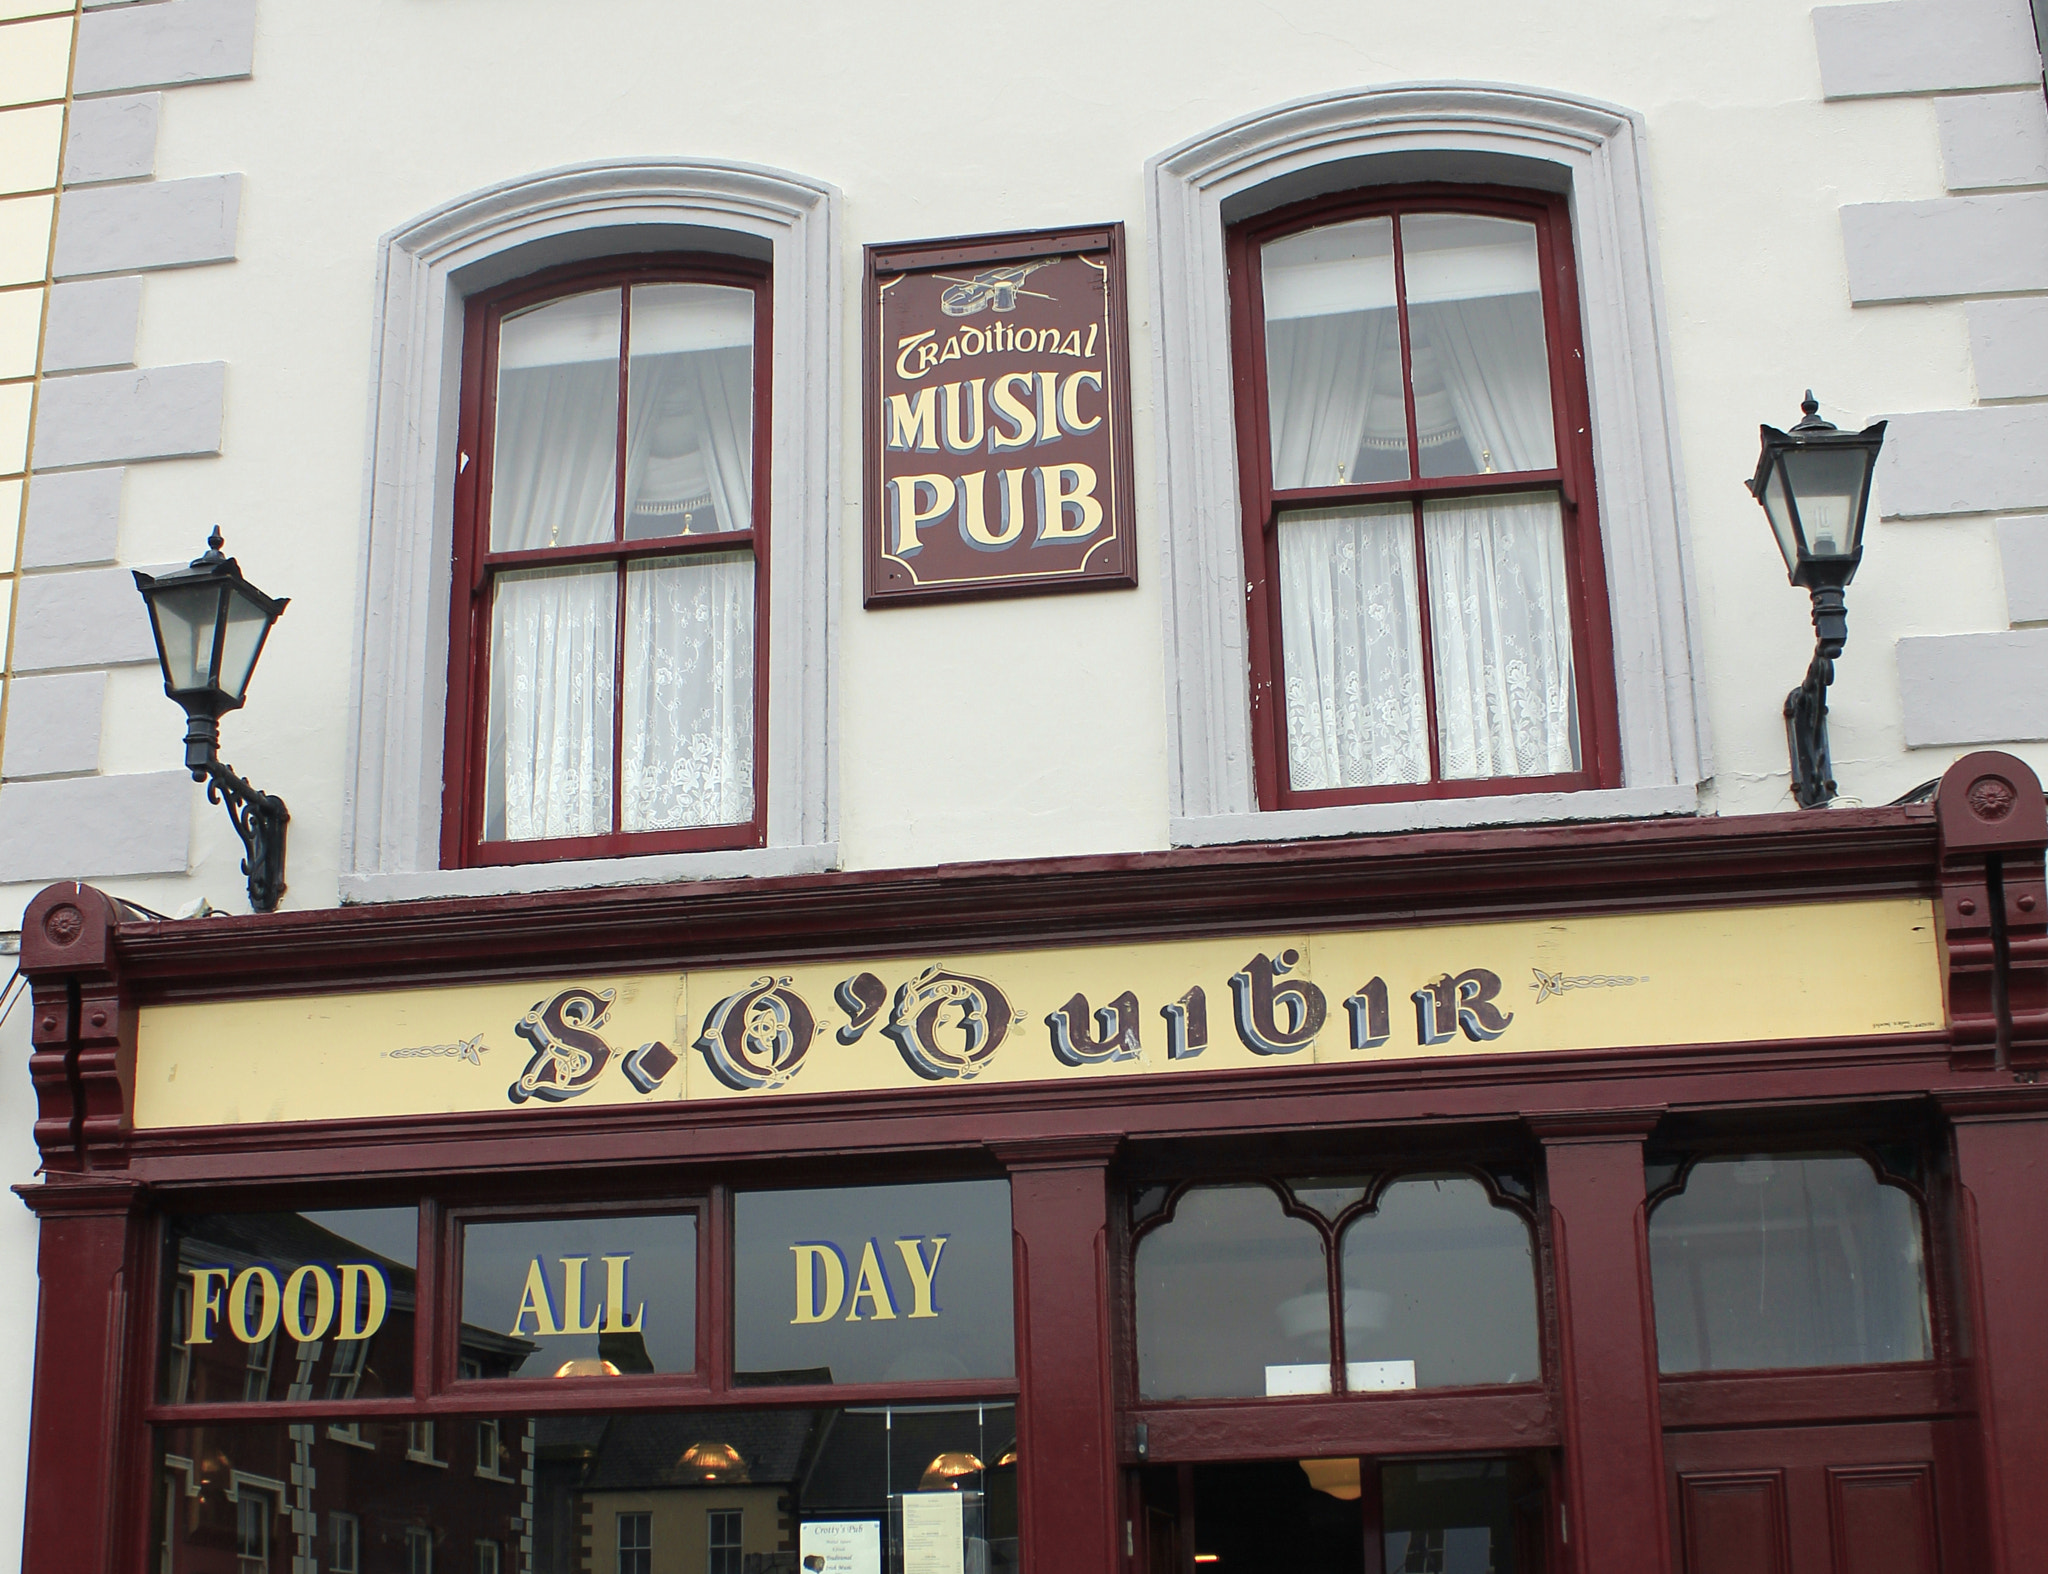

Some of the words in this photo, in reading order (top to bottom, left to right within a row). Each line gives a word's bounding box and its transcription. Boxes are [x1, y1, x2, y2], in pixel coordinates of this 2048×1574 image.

[895, 320, 1099, 380] Traditional
[885, 370, 1103, 454] MUSIC
[886, 463, 1104, 559] PUB
[185, 1260, 392, 1345] FOOD
[509, 1251, 648, 1338] ALL
[790, 1232, 951, 1326] DAY
[814, 1524, 846, 1536] Crotty's
[847, 1524, 864, 1534] Pub
